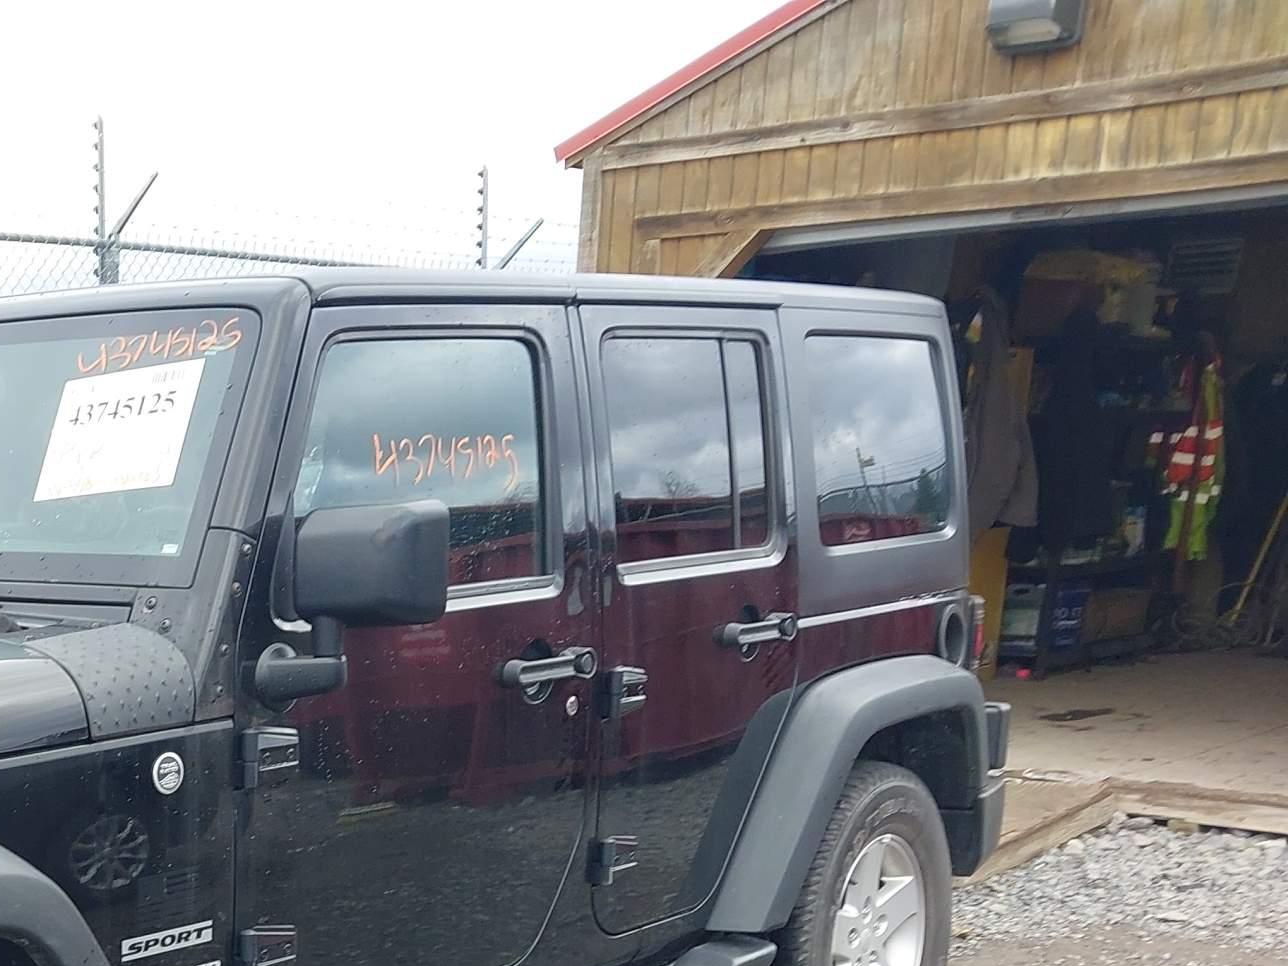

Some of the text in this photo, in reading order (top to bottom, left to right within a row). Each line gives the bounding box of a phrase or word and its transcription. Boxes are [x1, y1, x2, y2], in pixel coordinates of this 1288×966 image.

[77, 316, 242, 374] 43745125
[69, 390, 177, 426] 43745125
[372, 432, 519, 497] 43745125
[127, 927, 208, 955] SPORT
